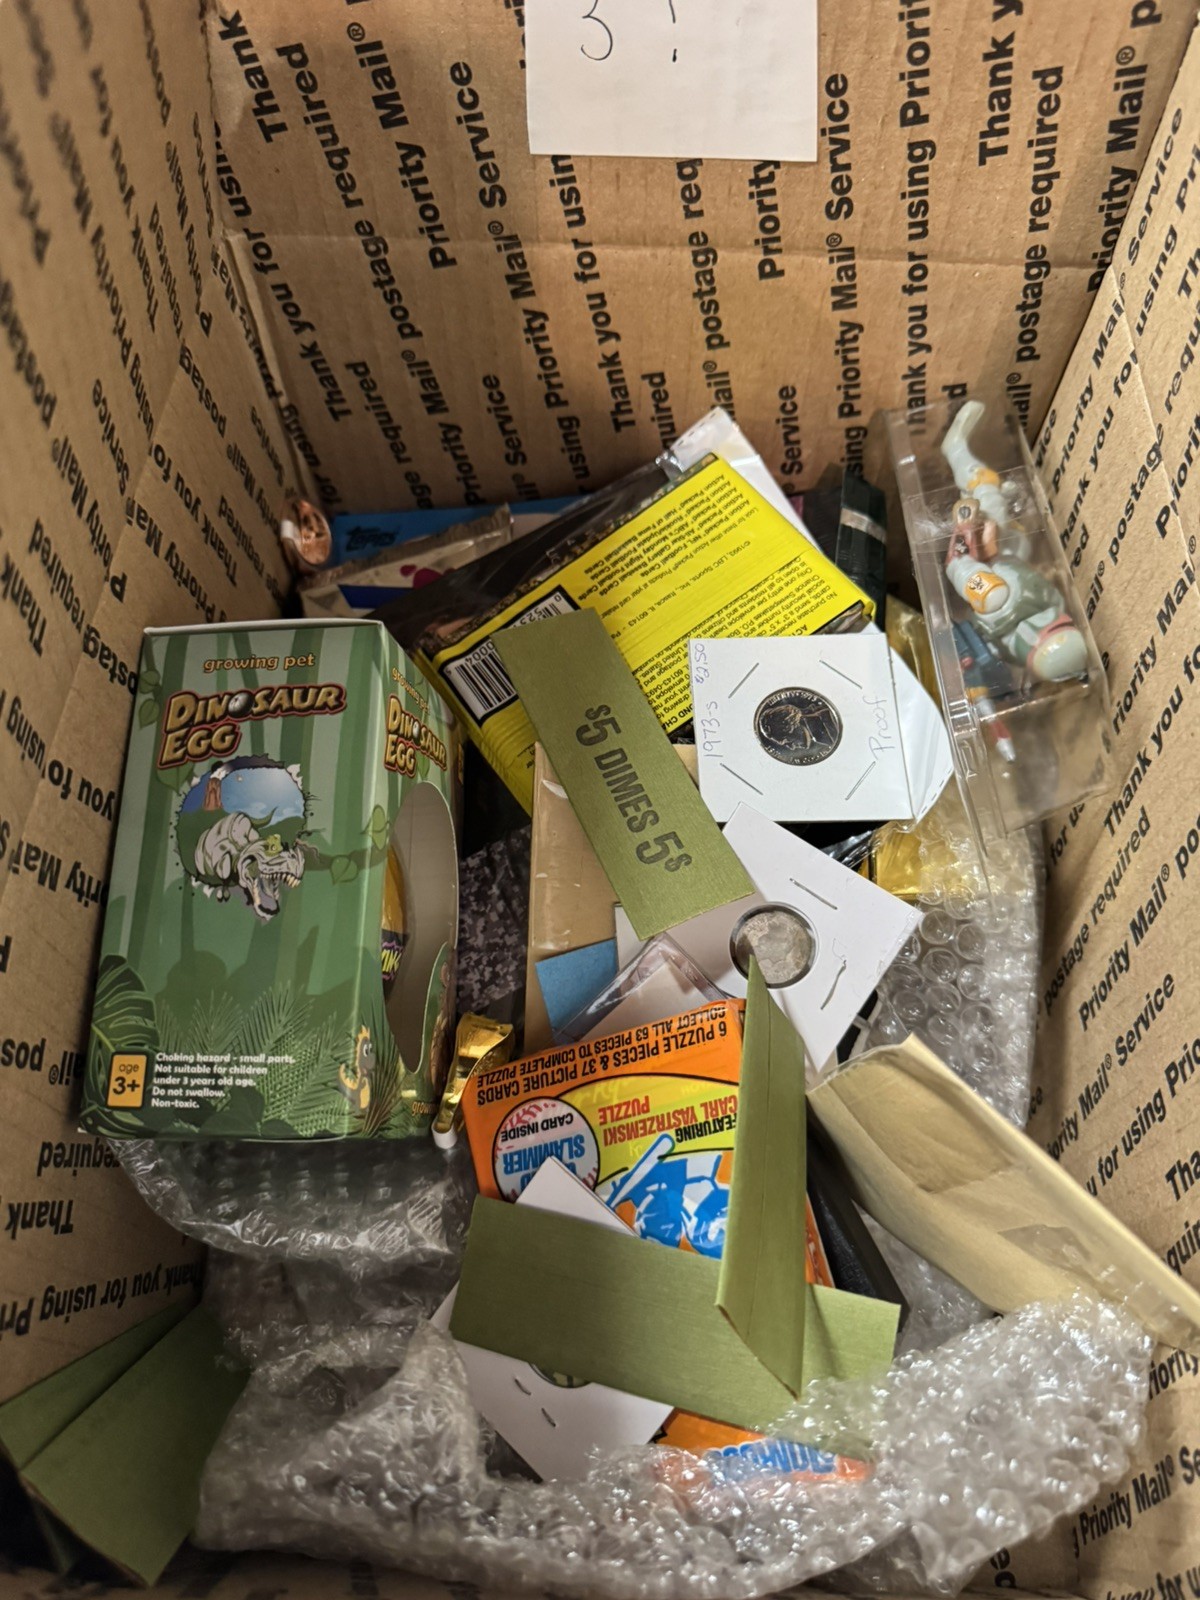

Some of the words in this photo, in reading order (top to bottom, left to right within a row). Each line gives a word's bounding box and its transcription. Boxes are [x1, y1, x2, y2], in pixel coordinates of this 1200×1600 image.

[218, 9, 288, 143] Thank
[347, 22, 410, 130] Mail®
[979, 31, 1016, 167] Thank
[1105, 45, 1149, 155] Mail®
[275, 42, 364, 208] required
[450, 62, 507, 208] Service
[820, 73, 855, 220] Service
[1027, 65, 1064, 234] required
[111, 135, 136, 219] you
[900, 139, 937, 242] using
[395, 141, 458, 269] Priority
[748, 160, 785, 281] Priority
[149, 201, 183, 339] required
[242, 227, 281, 275] for
[487, 221, 537, 300] Mail®
[571, 238, 601, 284] for
[131, 213, 158, 332] Thank
[354, 220, 424, 340] postage
[688, 230, 731, 351] postage
[825, 232, 858, 312] Mail®
[901, 250, 930, 298] for
[91, 223, 133, 369] Priority
[270, 282, 316, 336] you
[1016, 243, 1052, 363] postage
[1052, 374, 1094, 495] Priority
[1128, 107, 1183, 266] Service
[586, 292, 621, 345] you
[904, 304, 933, 361] you
[522, 308, 569, 410] Priority
[1089, 406, 1114, 473] you
[1135, 224, 1178, 337] using
[299, 340, 353, 422] Thank
[834, 320, 864, 419] Priority
[598, 350, 636, 432] Thank
[345, 361, 412, 464] required
[482, 374, 527, 466] Service
[775, 384, 804, 476] Service
[92, 378, 130, 497] Service
[251, 406, 285, 487] Service
[557, 415, 591, 488] using
[174, 471, 203, 523] you
[664, 509, 677, 520] Hall
[728, 500, 749, 516] Action
[1108, 422, 1164, 566] postage
[201, 513, 237, 588] Thank
[604, 536, 638, 562] Basketball
[637, 524, 656, 540] Fame
[643, 535, 669, 555] Monday
[584, 560, 604, 574] Cards
[590, 566, 610, 580] Cards
[610, 547, 637, 568] Football
[619, 561, 648, 582] Baseball
[624, 554, 643, 568] Night
[640, 563, 661, 577] Cards
[647, 545, 671, 563] Gallery
[660, 543, 687, 565] Football
[28, 516, 85, 634] required
[164, 541, 217, 623] Priority
[578, 585, 598, 601] Cards
[597, 567, 625, 587] Football
[599, 581, 619, 596] Cards
[631, 587, 643, 598] your
[766, 586, 783, 600] entry
[784, 577, 796, 587] one
[0, 552, 47, 658] Thank
[628, 611, 648, 627] 60143
[727, 605, 756, 626] envelope
[753, 592, 795, 621] Sweepstakes
[757, 597, 767, 606] per
[757, 610, 781, 628] number
[203, 655, 279, 673] growing
[283, 653, 315, 668] pet
[656, 656, 682, 676] postage
[662, 647, 684, 663] United
[643, 675, 656, 687] and
[657, 678, 684, 699] envelope
[664, 691, 678, 704] your
[663, 694, 689, 713] drawing
[6, 695, 47, 778] using
[158, 722, 243, 769] EGG
[862, 693, 896, 761] Proof
[385, 733, 415, 777] EGG
[1103, 747, 1152, 838] Thank
[1150, 684, 1184, 756] you
[77, 777, 117, 821] you
[593, 747, 660, 834] DIMES
[1043, 923, 1089, 1017] postage
[1090, 805, 1151, 926] required
[1078, 940, 1131, 1032] Priority
[1129, 863, 1170, 947] Mail®
[635, 1027, 649, 1043] 63
[652, 1018, 673, 1037] ALL
[662, 1023, 715, 1053] PUZZLE
[676, 1005, 726, 1030] COLLECT
[718, 1020, 727, 1037] 6
[156, 1052, 195, 1064] Choking
[196, 1053, 231, 1063] hazard
[239, 1053, 265, 1063] small
[267, 1053, 296, 1065] parts.
[519, 1049, 576, 1073] COMPLETE
[578, 1044, 592, 1058] TO
[594, 1031, 633, 1052] PIECES
[612, 1038, 660, 1069] PIECES
[1078, 1053, 1112, 1121] Mail®
[1115, 973, 1175, 1066] Service
[118, 1062, 140, 1074] age
[153, 1075, 180, 1085] under
[182, 1076, 189, 1085] 3
[190, 1077, 215, 1087] years
[217, 1076, 233, 1086] old
[235, 1078, 256, 1087] age.
[154, 1064, 172, 1073] Not
[173, 1064, 211, 1074] suitable
[213, 1064, 227, 1074] for
[228, 1064, 267, 1074] children
[476, 1064, 517, 1089] PUZZLE
[521, 1063, 578, 1094] PICTURE
[581, 1058, 597, 1076] 37
[599, 1055, 610, 1070] &
[112, 1076, 140, 1095] 3+
[151, 1097, 200, 1109] Non-toxic.
[152, 1086, 165, 1097] Do
[167, 1087, 183, 1097] not
[185, 1088, 226, 1097] swallow.
[476, 1080, 520, 1105] CARDS
[540, 1113, 574, 1132] CARD
[598, 1096, 651, 1126] PUZZLE
[603, 1105, 697, 1146] YASTRZEMSKI
[701, 1095, 738, 1120] CARL
[500, 1122, 539, 1142] INSIDE
[675, 1115, 737, 1143] FEATURING
[1097, 1145, 1120, 1187] for
[1121, 1088, 1167, 1157] using
[502, 1133, 585, 1174] SLAMMER
[5, 1199, 73, 1240] Thank
[100, 1276, 129, 1308] for
[132, 1263, 162, 1294] you
[39, 1281, 95, 1323] using
[1079, 1488, 1132, 1546] Priority
[1132, 1454, 1175, 1514] Mail®
